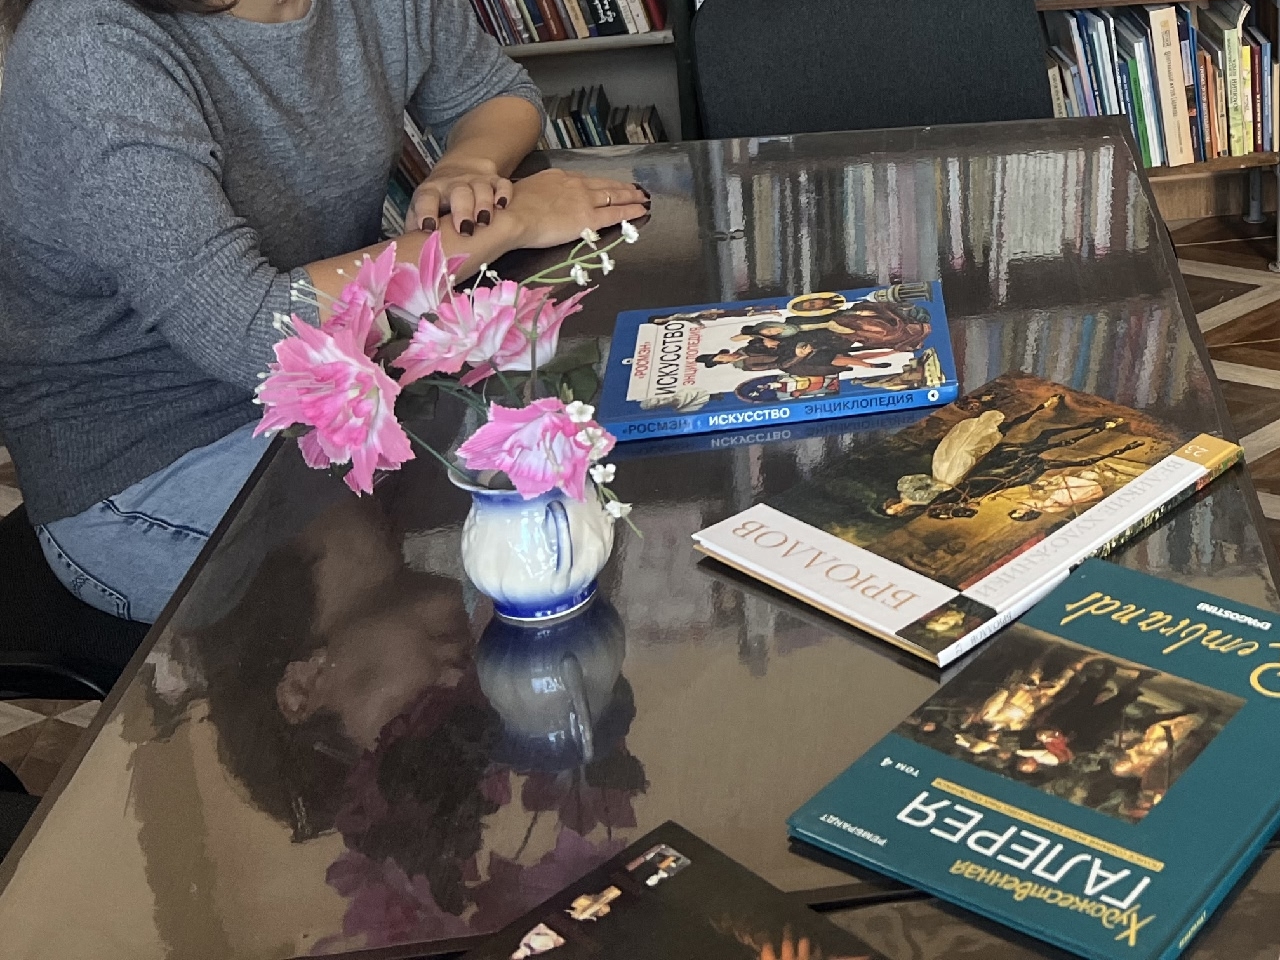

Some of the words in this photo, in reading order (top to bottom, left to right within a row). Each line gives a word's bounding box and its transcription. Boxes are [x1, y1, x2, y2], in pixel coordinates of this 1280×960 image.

[633, 342, 650, 380] «РОСМЭН»
[655, 320, 685, 397] ИСКУССТВО
[681, 326, 703, 387] ЭНЦИКЛОПЕДИЯ
[708, 407, 790, 426] ИСКУССТВО
[804, 393, 914, 416] ЭНЦИКЛОПЕДИЯ
[1101, 457, 1184, 526] ВЕЛИКИЕ
[732, 517, 920, 613] БРЮЛЛОВ
[978, 506, 1106, 599] ХУДОЖНИКИ
[879, 756, 894, 767] 4
[818, 813, 888, 847] РЕМБРАНДТ
[895, 788, 1152, 911] ГАЛЕРЕЯ
[949, 858, 1157, 947] Художественная
